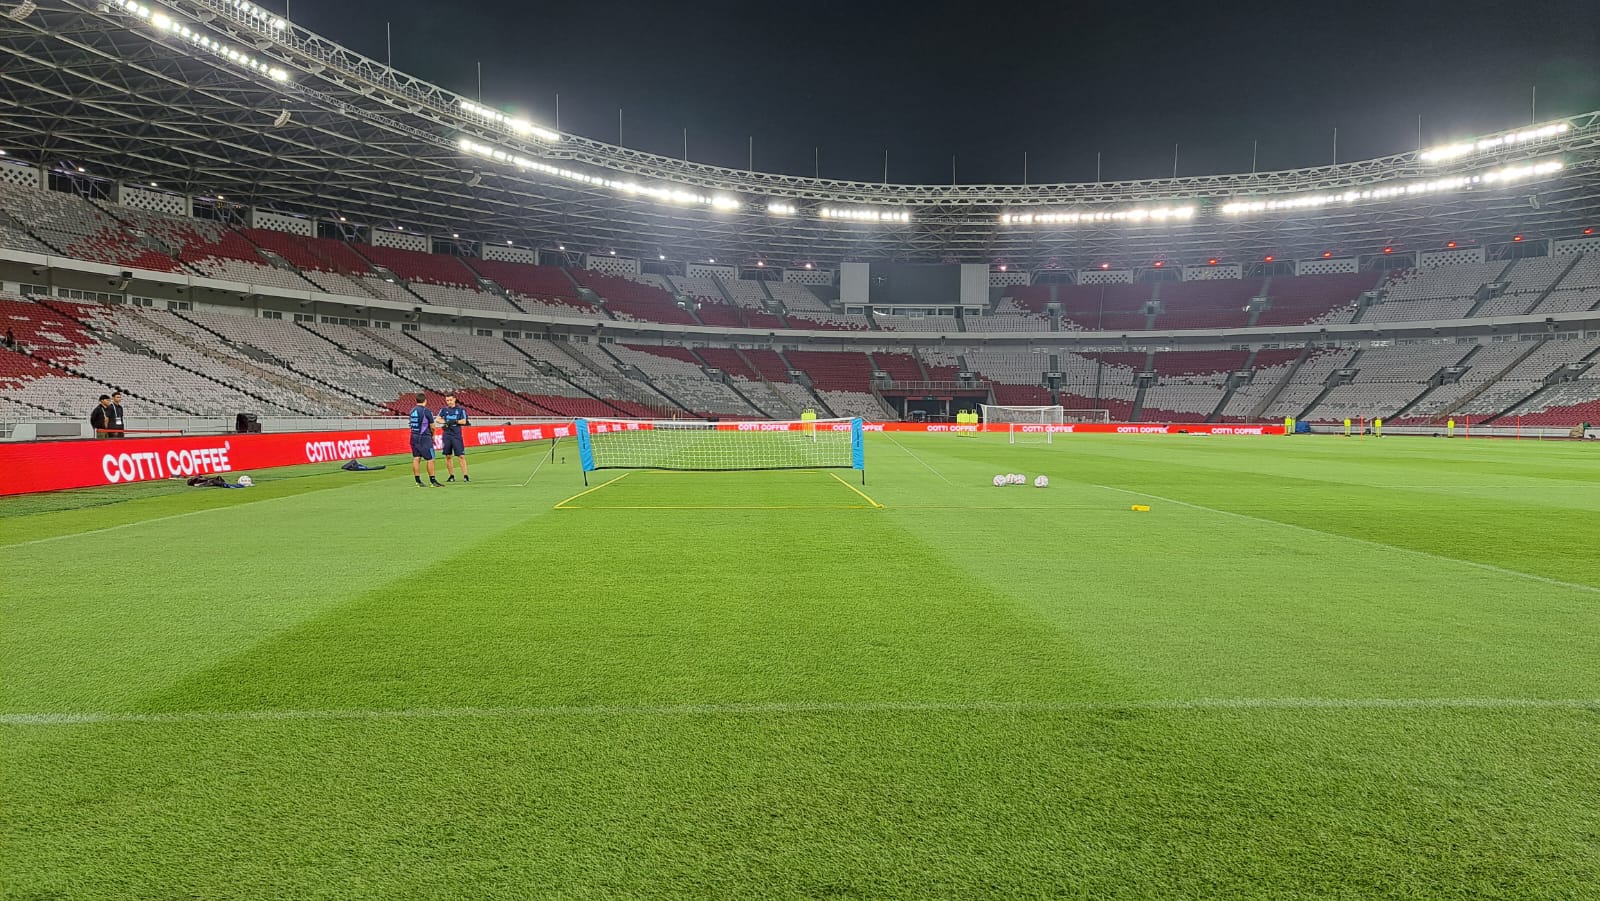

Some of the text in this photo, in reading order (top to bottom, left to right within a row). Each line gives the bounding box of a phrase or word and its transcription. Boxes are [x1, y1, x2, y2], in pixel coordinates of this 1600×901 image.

[1139, 426, 1168, 434] COFFEE
[1234, 427, 1261, 435] COFFEE
[306, 439, 372, 462] COTTI COFFEE
[102, 448, 231, 483] COTTI COFFEE
